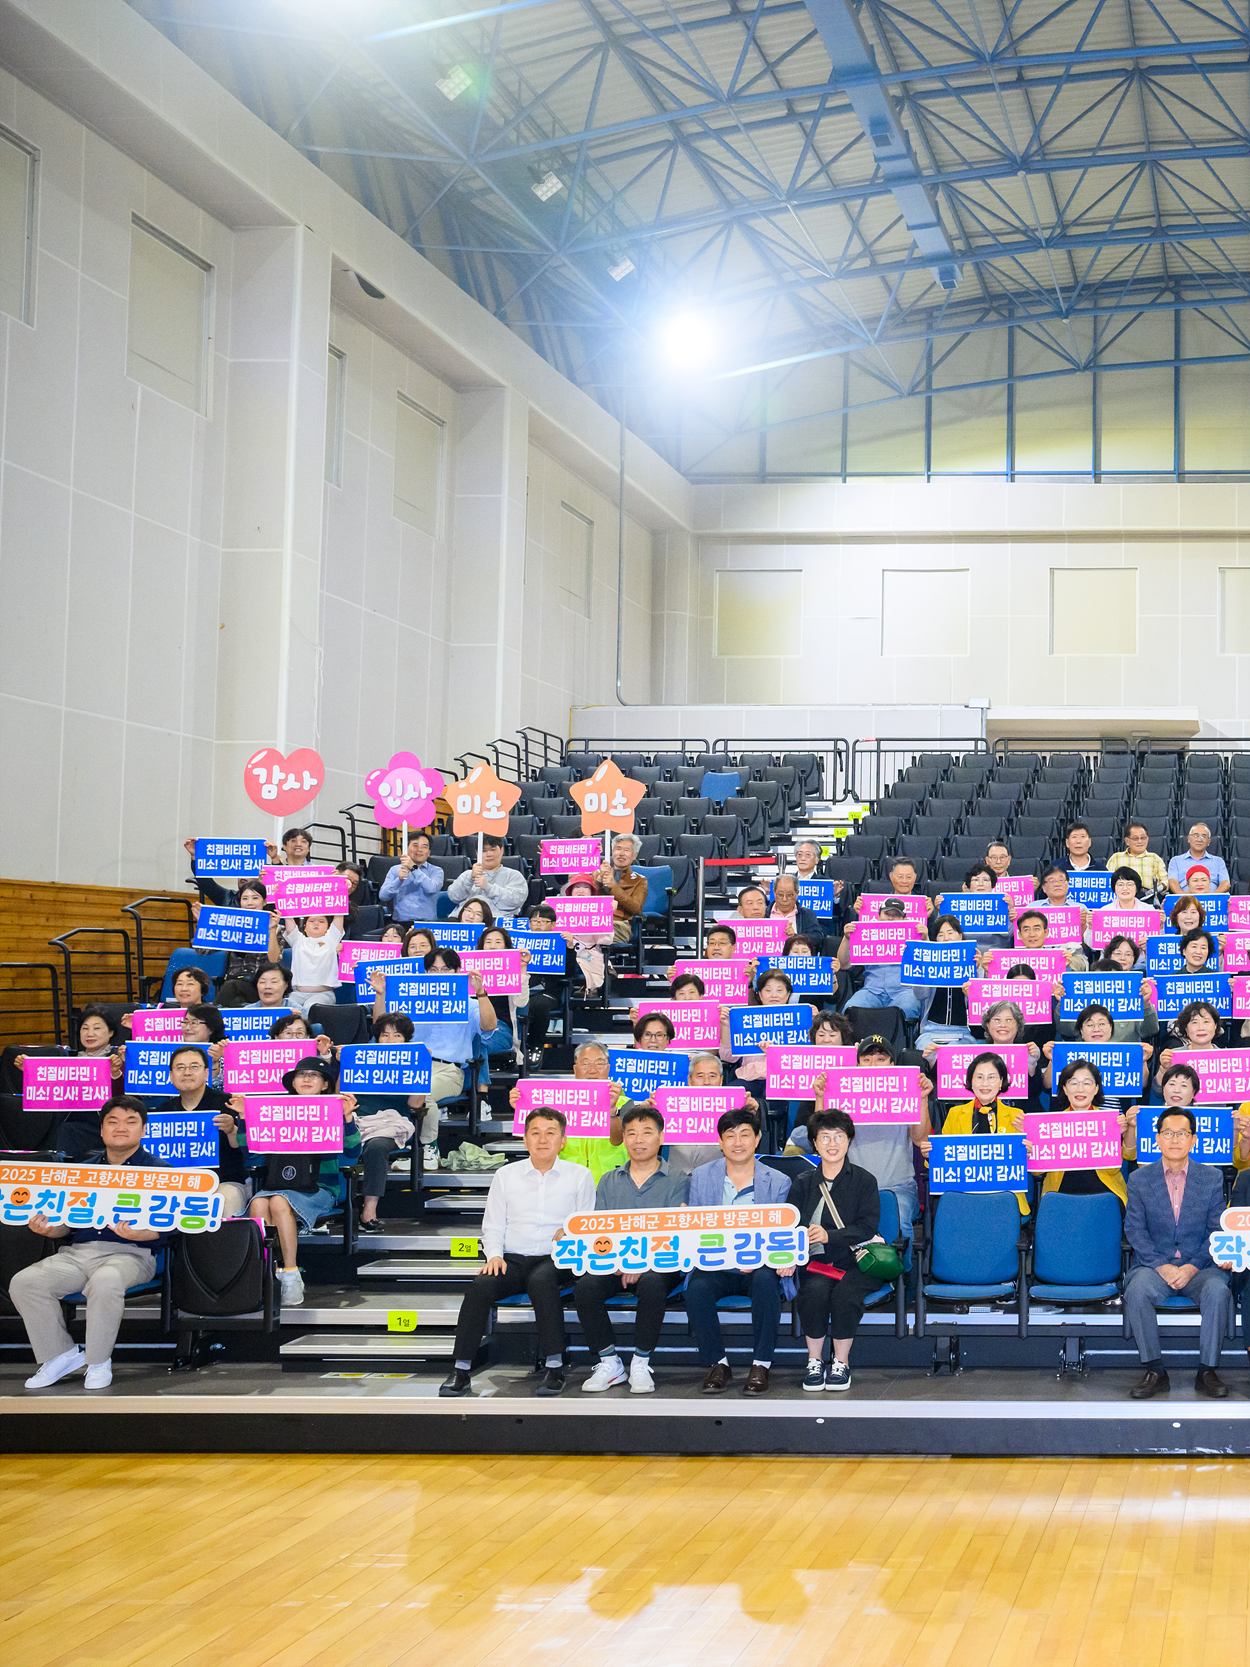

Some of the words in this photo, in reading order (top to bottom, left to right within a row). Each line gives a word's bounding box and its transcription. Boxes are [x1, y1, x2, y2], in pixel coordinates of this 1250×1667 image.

[253, 765, 317, 799] 감사
[378, 778, 432, 808] 인사
[457, 791, 506, 819] 미소
[584, 789, 632, 817] 미소
[198, 859, 218, 869] 미소!
[221, 859, 241, 870] 인사!
[542, 858, 559, 867] 미소!
[562, 857, 579, 867] 인사!
[582, 857, 599, 866] 감사!
[278, 898, 298, 909] 미소!
[301, 896, 322, 908] 인사!
[325, 895, 346, 907] 감사!
[197, 928, 219, 940] 미소!
[222, 930, 242, 943] 인사!
[245, 933, 266, 944] 감사!
[853, 945, 873, 956] 미소!
[876, 944, 896, 956] 인사!
[904, 964, 925, 977] 미소!
[928, 966, 950, 978] 인사!
[953, 966, 976, 978] 감사!
[390, 1001, 411, 1014] 미소!
[415, 1001, 439, 1014] 인사!
[443, 1001, 465, 1013] 감사!
[344, 1070, 369, 1083] 미소!
[373, 1070, 398, 1084] 인사!
[403, 1070, 428, 1084] 감사!
[27, 1086, 50, 1100] 미소!
[53, 1086, 78, 1100] 인사!
[82, 1086, 108, 1100] 감사!
[860, 1098, 887, 1113] 인사!
[891, 1098, 918, 1113] 감사!
[250, 1127, 275, 1142] 미소!
[280, 1127, 307, 1142] 인사!
[312, 1127, 340, 1142] 감사!
[1059, 1143, 1086, 1159] 인사!
[1091, 1142, 1118, 1157] 감사!
[2, 1168, 36, 1182] 2025
[41, 1170, 81, 1185] 남해군
[84, 1172, 139, 1187] 고향사랑
[143, 1173, 183, 1189] 방문의
[188, 1175, 200, 1189] 해
[933, 1167, 960, 1183] 미소!
[965, 1166, 992, 1182] 인사!
[997, 1165, 1024, 1181] 감사!
[0, 1188, 104, 1225] 은친절,
[113, 1193, 142, 1225] 큰
[149, 1195, 221, 1229] 감동!
[580, 1218, 615, 1231] 2025
[619, 1215, 659, 1230] 남해군
[664, 1213, 719, 1228] 고향사랑
[723, 1211, 764, 1226] 방문의
[768, 1210, 782, 1225] 해
[459, 1243, 471, 1252] 2열
[697, 1233, 727, 1266] 큰
[734, 1230, 805, 1265] 감동!
[397, 1317, 410, 1327] 1열
